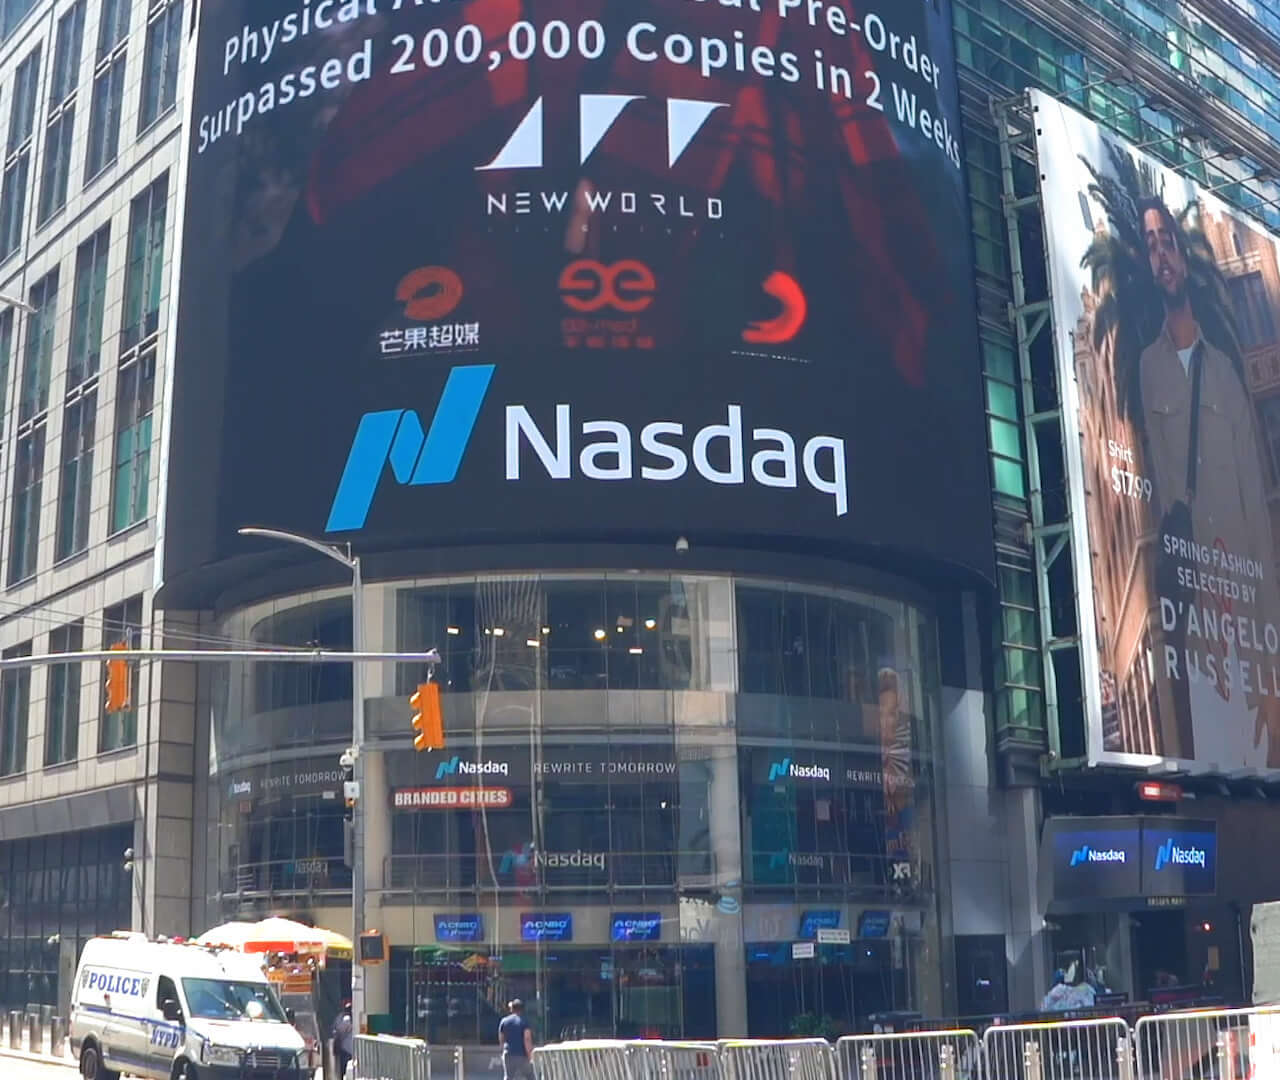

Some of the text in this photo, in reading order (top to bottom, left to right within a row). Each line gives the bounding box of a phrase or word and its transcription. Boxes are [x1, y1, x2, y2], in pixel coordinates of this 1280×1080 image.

[197, 19, 963, 170] Surpassed 200,000 Copies in 2 Weeks
[487, 191, 723, 219] NEW WORLD
[379, 322, 480, 353] 芒果超媒
[504, 403, 848, 518] Nasdaq
[1108, 440, 1134, 465] Shirt
[1111, 467, 1153, 503] $17.99
[1163, 533, 1264, 581] SPRING FASHION
[1177, 566, 1257, 604] SELECTED BY
[1160, 596, 1279, 655] D'ANGELO
[459, 760, 509, 777] Nasdaq
[533, 762, 677, 774] REWRITE TOMORROW
[789, 764, 831, 782] Nasdaq
[394, 789, 508, 807] BRANDED CITIES
[533, 850, 606, 870] Nasdaq
[1088, 849, 1126, 863] Nasdaq
[1172, 846, 1206, 869] Nasdaq
[88, 970, 141, 997] POLICE
[149, 1025, 180, 1049] NYPD
